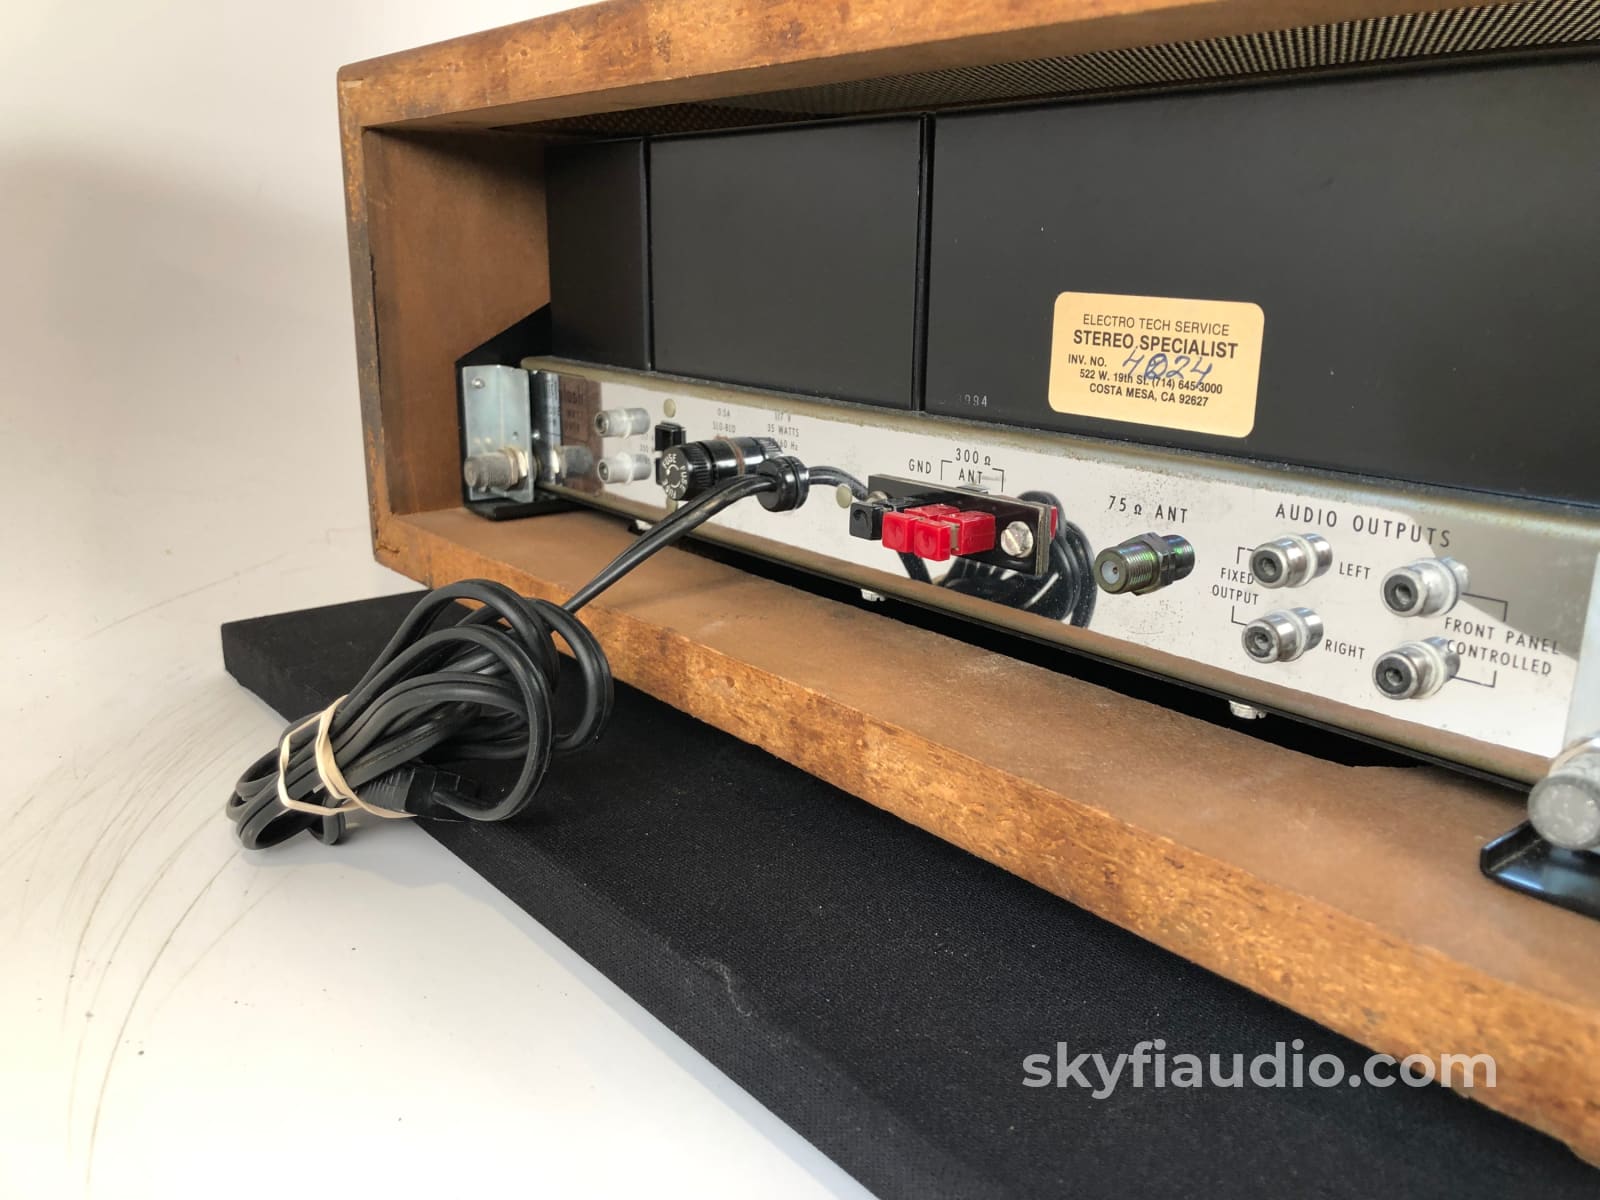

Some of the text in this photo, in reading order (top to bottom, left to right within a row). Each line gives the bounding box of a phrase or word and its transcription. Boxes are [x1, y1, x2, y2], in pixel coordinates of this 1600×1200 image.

[1083, 313, 1230, 336] ELECTRO TECH SERVICE
[1073, 329, 1238, 359] STEREO SPECIALIST
[1068, 353, 1107, 368] INV. NO.
[1079, 368, 1096, 380] 522
[1098, 370, 1111, 382] W.
[1113, 372, 1134, 384] 19th
[1151, 376, 1176, 391] (714)
[1178, 379, 1223, 395] 645-3000
[1089, 383, 1209, 407] COSTA MESA, CA 92627
[778, 425, 800, 438] WATTS
[908, 458, 932, 475] GND
[956, 448, 980, 464] 300
[958, 469, 984, 485] ANT
[1109, 495, 1128, 513] 75
[1155, 505, 1189, 525] ANT
[1275, 503, 1452, 549] AUDIO OUTPUTS
[1220, 567, 1255, 586] FIXED
[1339, 561, 1372, 580] LEFT
[1211, 585, 1260, 606] OUTPUT
[1444, 616, 1560, 655] FRONT PANEL
[1324, 639, 1366, 661] RIGHT
[1446, 639, 1553, 677] CONTROLLED
